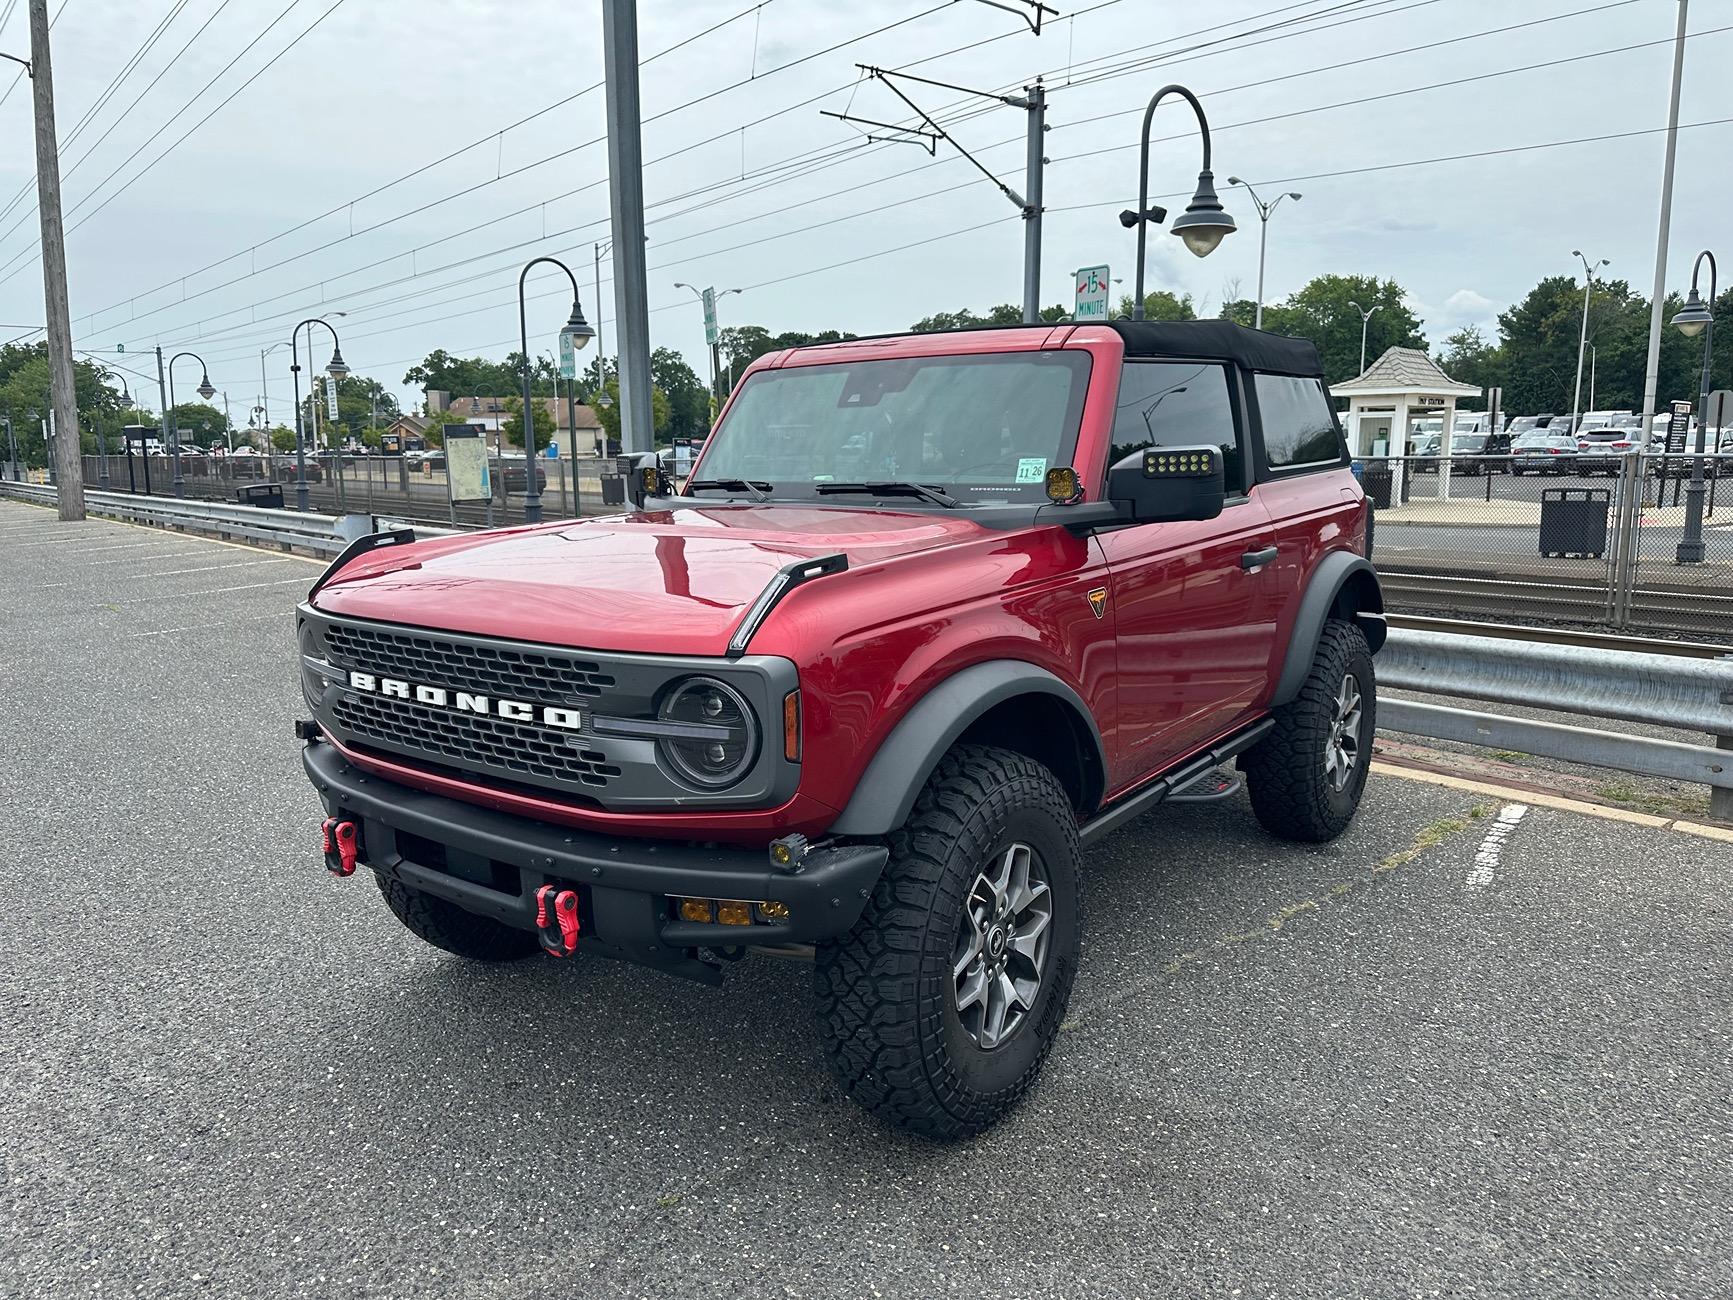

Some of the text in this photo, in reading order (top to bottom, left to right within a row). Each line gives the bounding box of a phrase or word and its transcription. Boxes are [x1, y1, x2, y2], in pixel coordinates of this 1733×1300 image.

[1087, 274, 1098, 294] 15
[1078, 299, 1104, 316] MINUTE
[1019, 468, 1029, 478] 11
[1032, 465, 1043, 476] 26
[350, 671, 582, 729] BRONCO
